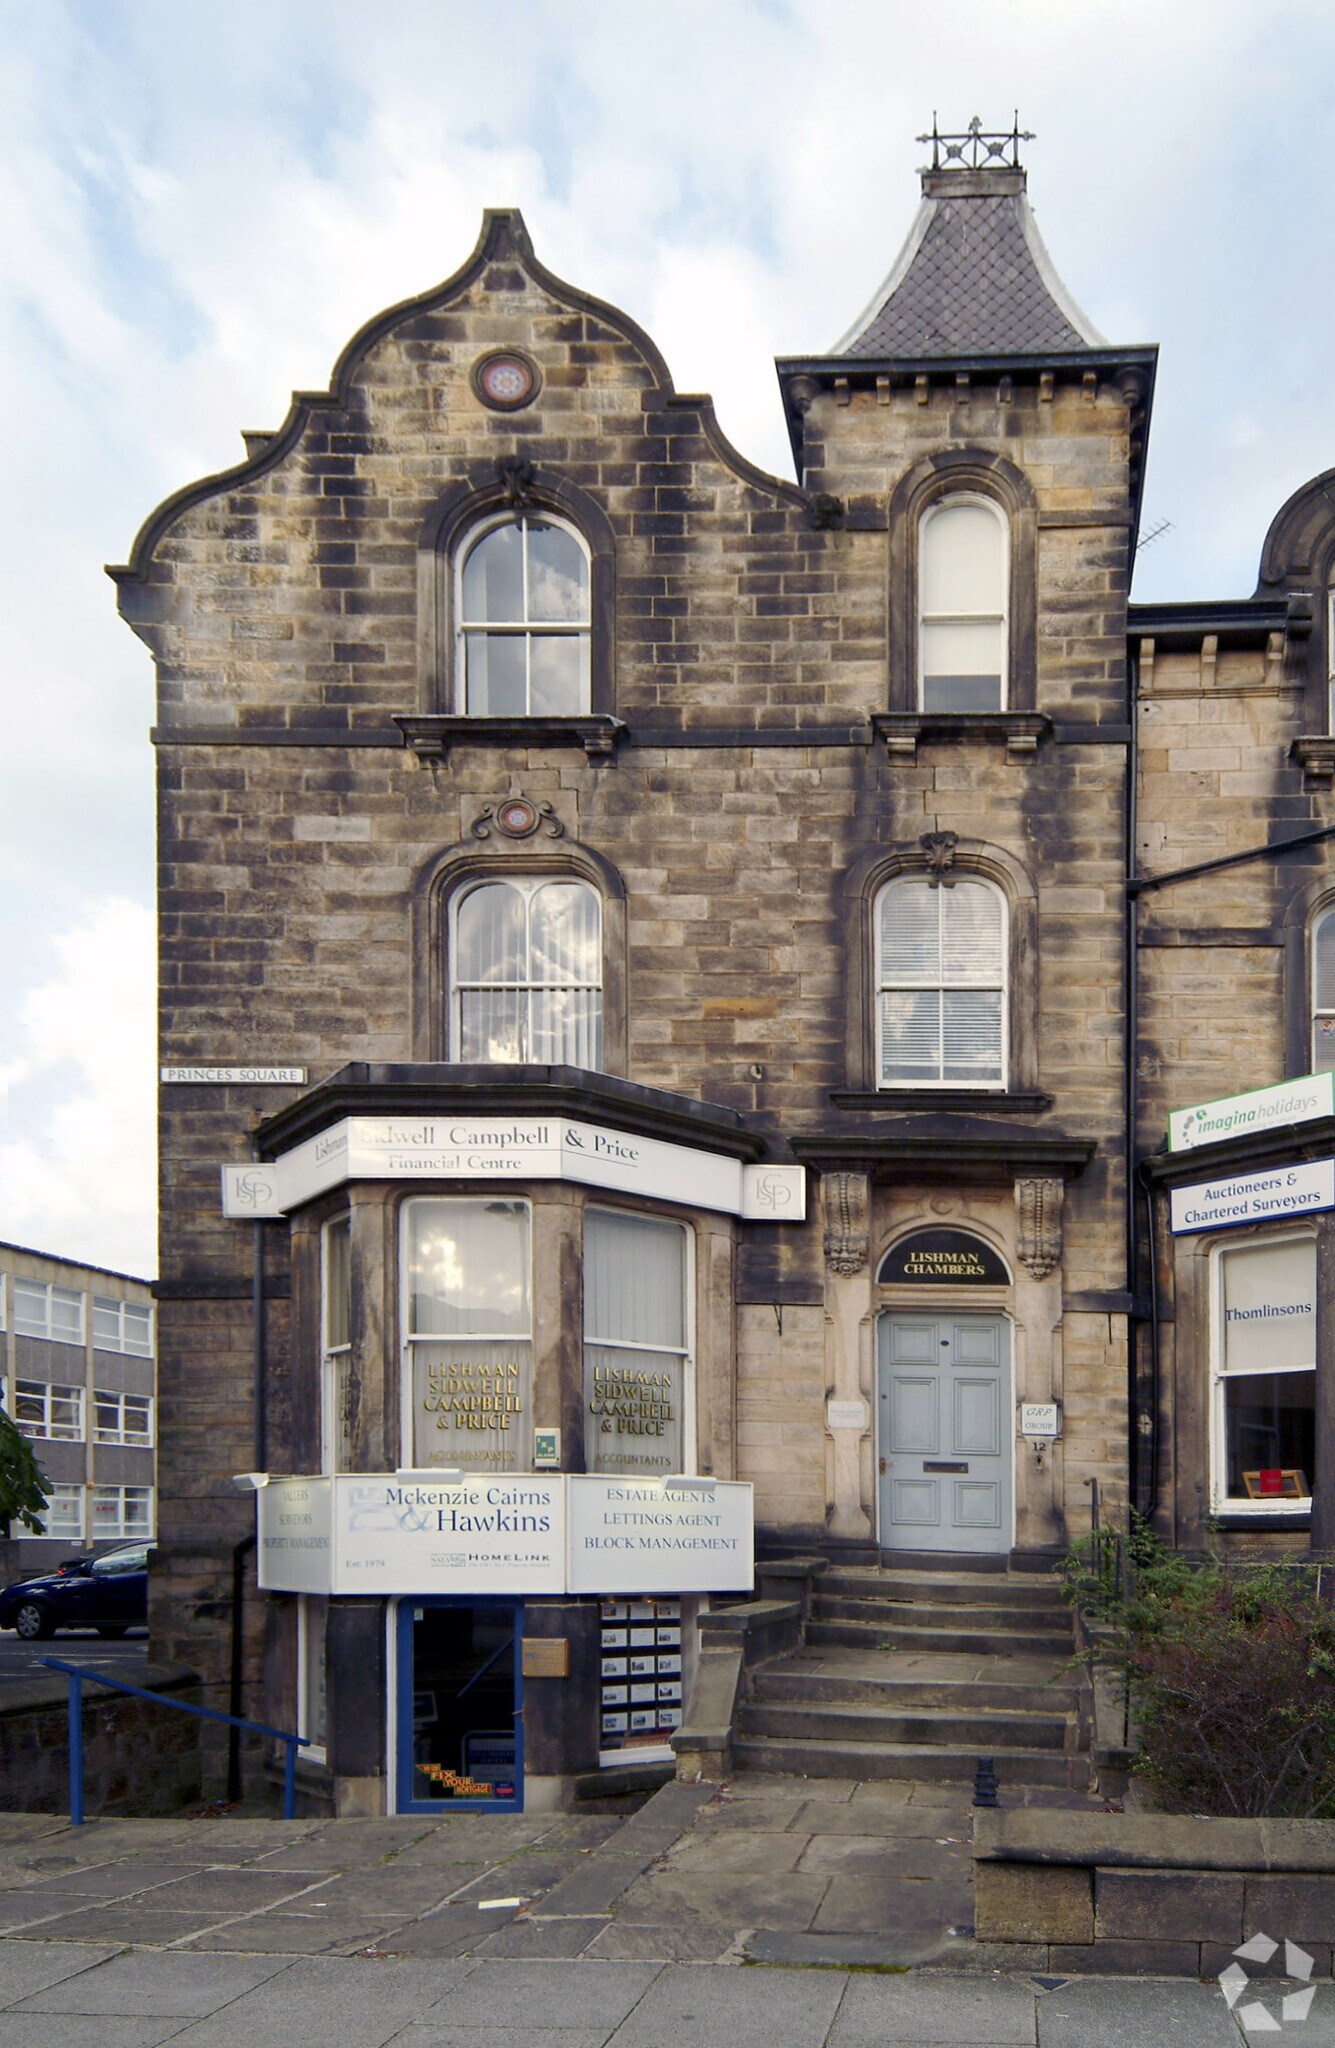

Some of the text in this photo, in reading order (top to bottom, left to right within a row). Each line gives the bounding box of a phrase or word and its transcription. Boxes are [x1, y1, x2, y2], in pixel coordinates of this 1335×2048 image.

[168, 1069, 298, 1081] PRINCES SQUARE
[449, 1126, 549, 1148] Campbell
[565, 1129, 585, 1148] &
[594, 1135, 639, 1160] Price
[389, 1155, 522, 1169] Financial Centre
[1204, 1173, 1297, 1201] Auctioneers &
[1184, 1191, 1321, 1223] Chartered Surveyors
[910, 1252, 979, 1264] LISHMAN
[904, 1264, 985, 1275] CHAMBERS
[1225, 1303, 1312, 1321] Thomlinsons
[428, 1363, 518, 1377] LISHMAN
[594, 1366, 671, 1387] LISHMAN
[429, 1379, 516, 1394] SIDWELL
[595, 1384, 670, 1403] SIDWELL
[424, 1396, 522, 1412] CAMPBELL
[590, 1399, 675, 1420] CAMPBELL
[437, 1414, 510, 1429] & PRICE
[601, 1419, 664, 1436] & PRICE
[1032, 1442, 1046, 1451] 12
[595, 1452, 671, 1466] ACCOUNTANTS
[385, 1488, 550, 1505] Mckenzie Cairns
[607, 1488, 715, 1503] ESTATE AGENTS
[400, 1504, 550, 1532] & Hawkins
[603, 1513, 722, 1526] LETTINGS AGENT
[584, 1537, 738, 1550] BLOCK MANAGEMENT
[365, 1560, 385, 1568] 1979
